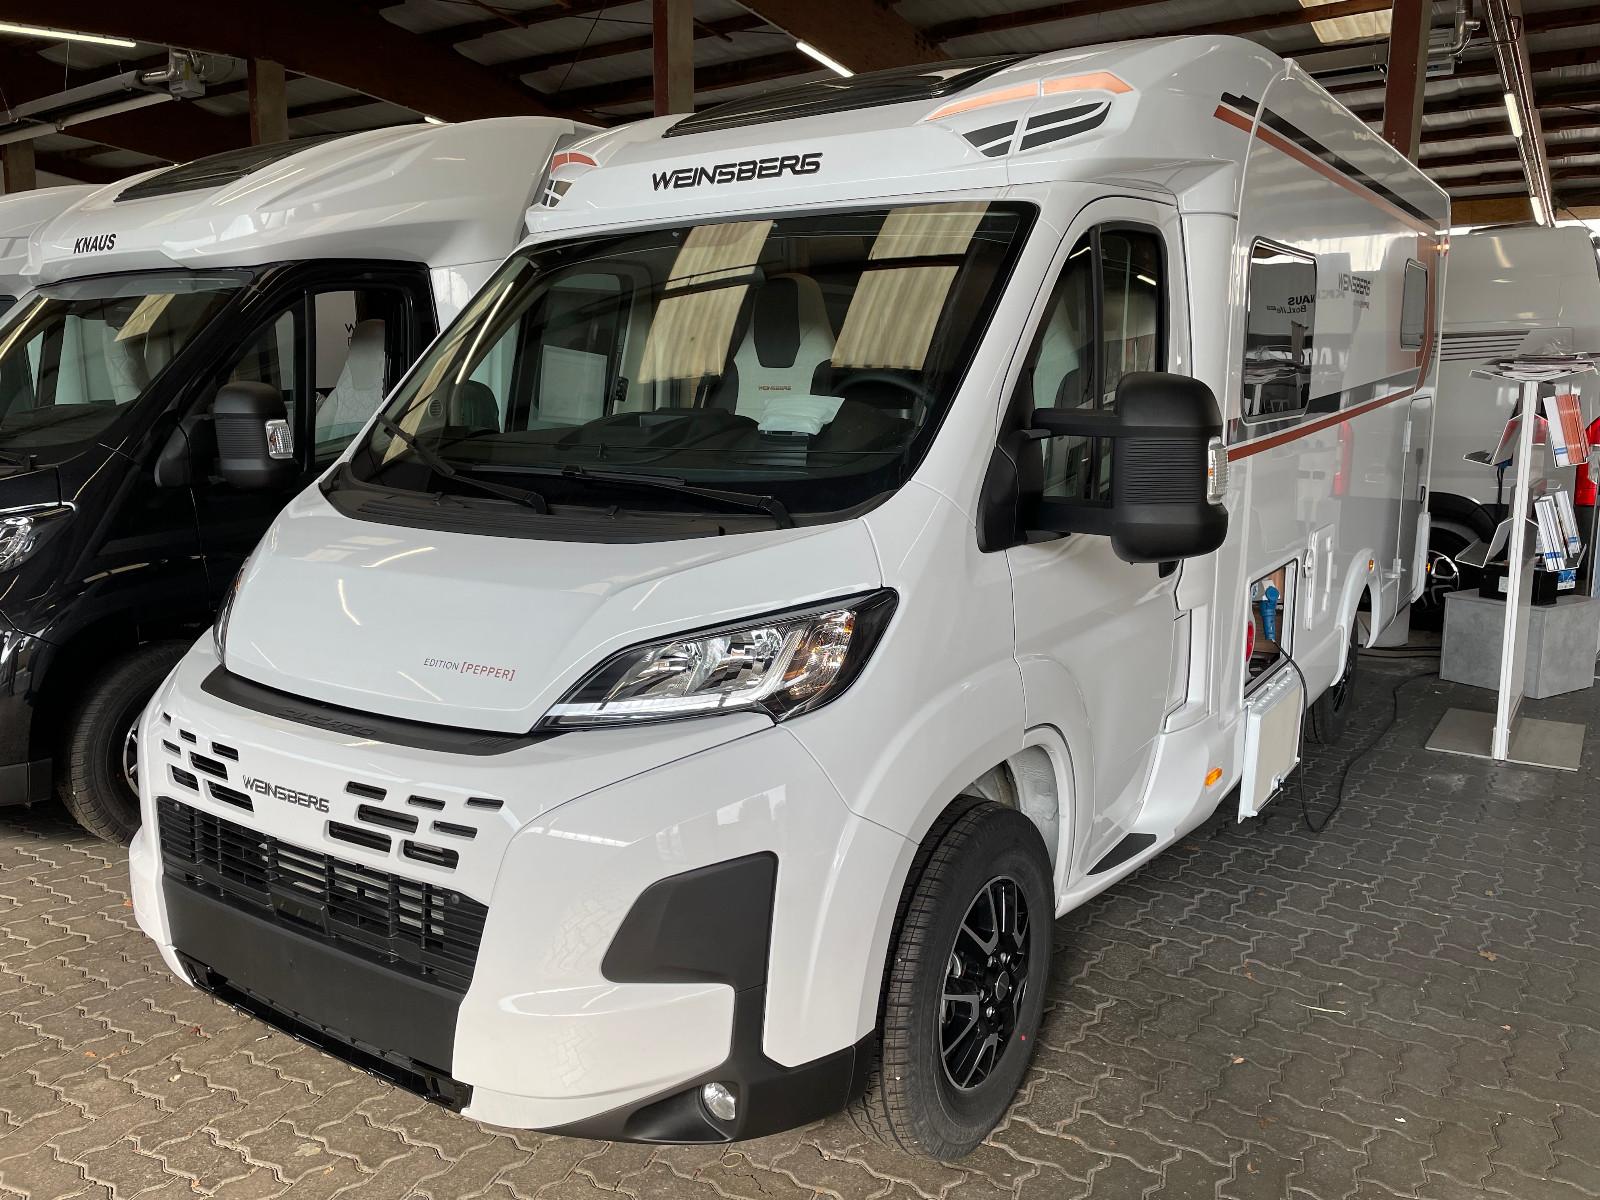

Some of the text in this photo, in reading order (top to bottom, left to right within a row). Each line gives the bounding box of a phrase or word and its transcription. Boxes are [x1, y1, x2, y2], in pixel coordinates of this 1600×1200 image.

[652, 152, 823, 192] WEINSBERG
[73, 233, 117, 254] KNAUS
[423, 657, 516, 682] EDITION [PEPPER]
[242, 774, 330, 814] WEINSBERG
